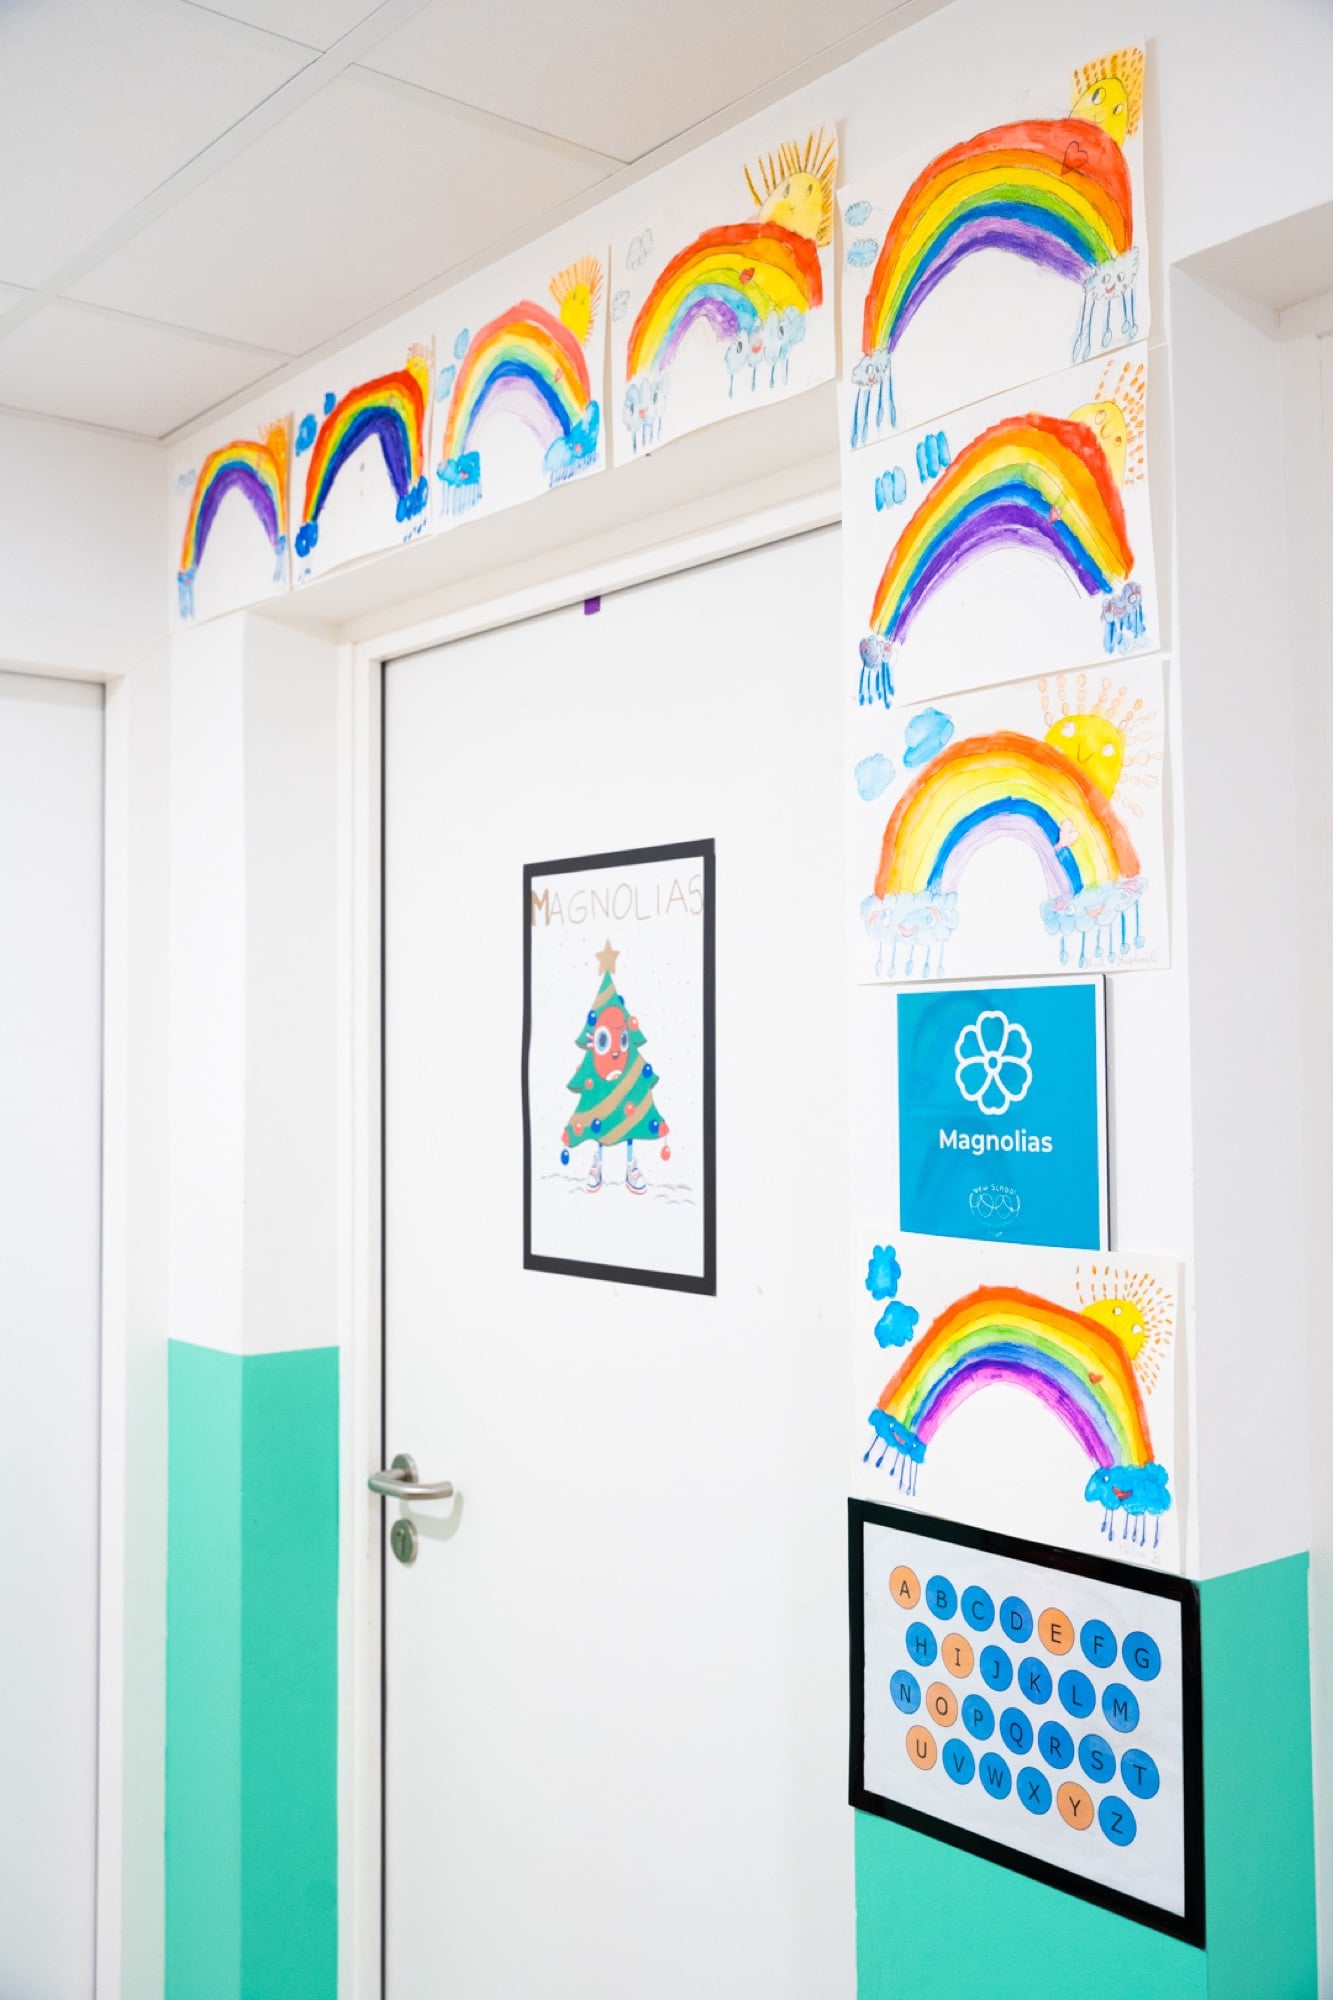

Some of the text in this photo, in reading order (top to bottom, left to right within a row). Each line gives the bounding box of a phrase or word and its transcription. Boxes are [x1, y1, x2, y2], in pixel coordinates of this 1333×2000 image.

[530, 874, 704, 927] MAGNOLIAS
[939, 1128, 1053, 1156] Magnolias
[900, 1580, 1148, 1668] A B C D E F G
[916, 1637, 1127, 1721] H I J K L M
[901, 1684, 1146, 1785] N O P Q R S T
[917, 1739, 1123, 1834] U V W X Y Z
